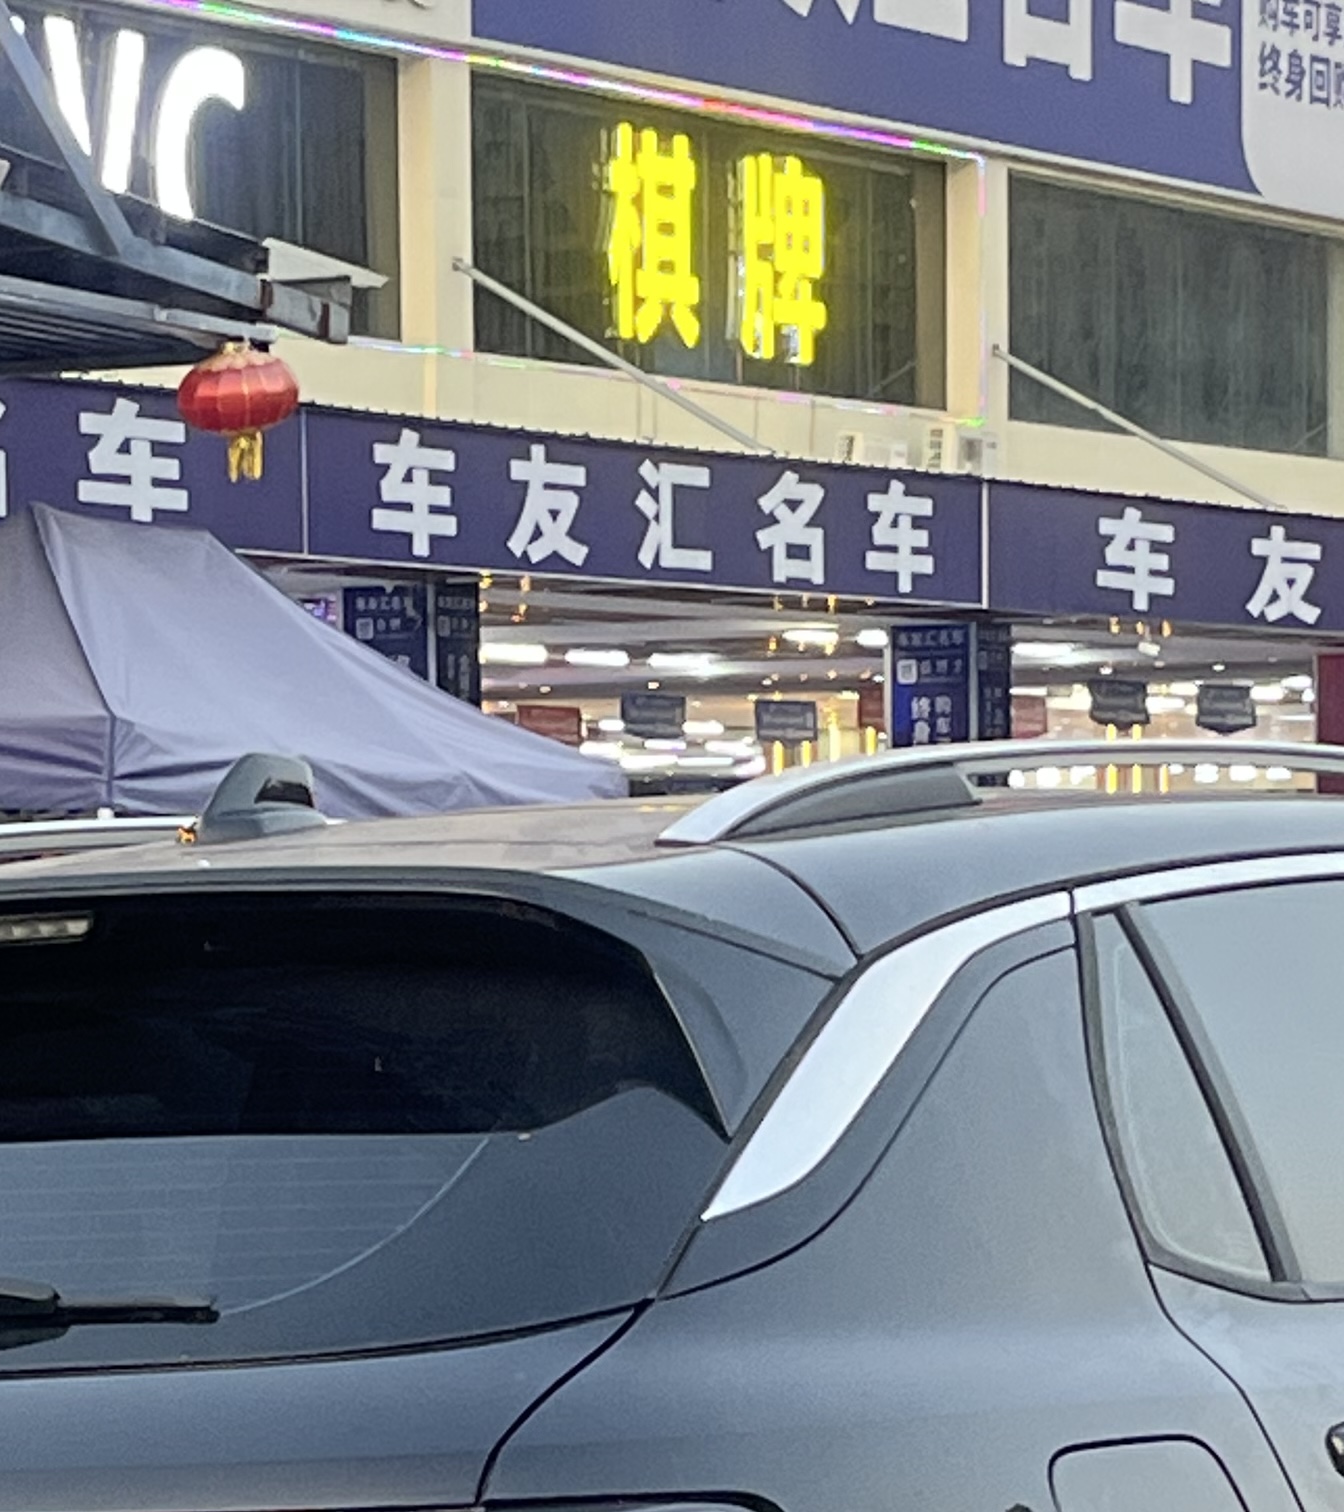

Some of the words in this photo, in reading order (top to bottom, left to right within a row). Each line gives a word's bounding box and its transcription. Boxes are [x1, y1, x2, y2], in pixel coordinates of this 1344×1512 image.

[606, 121, 827, 366] 棋牌
[371, 429, 935, 594] 车友汇名车
